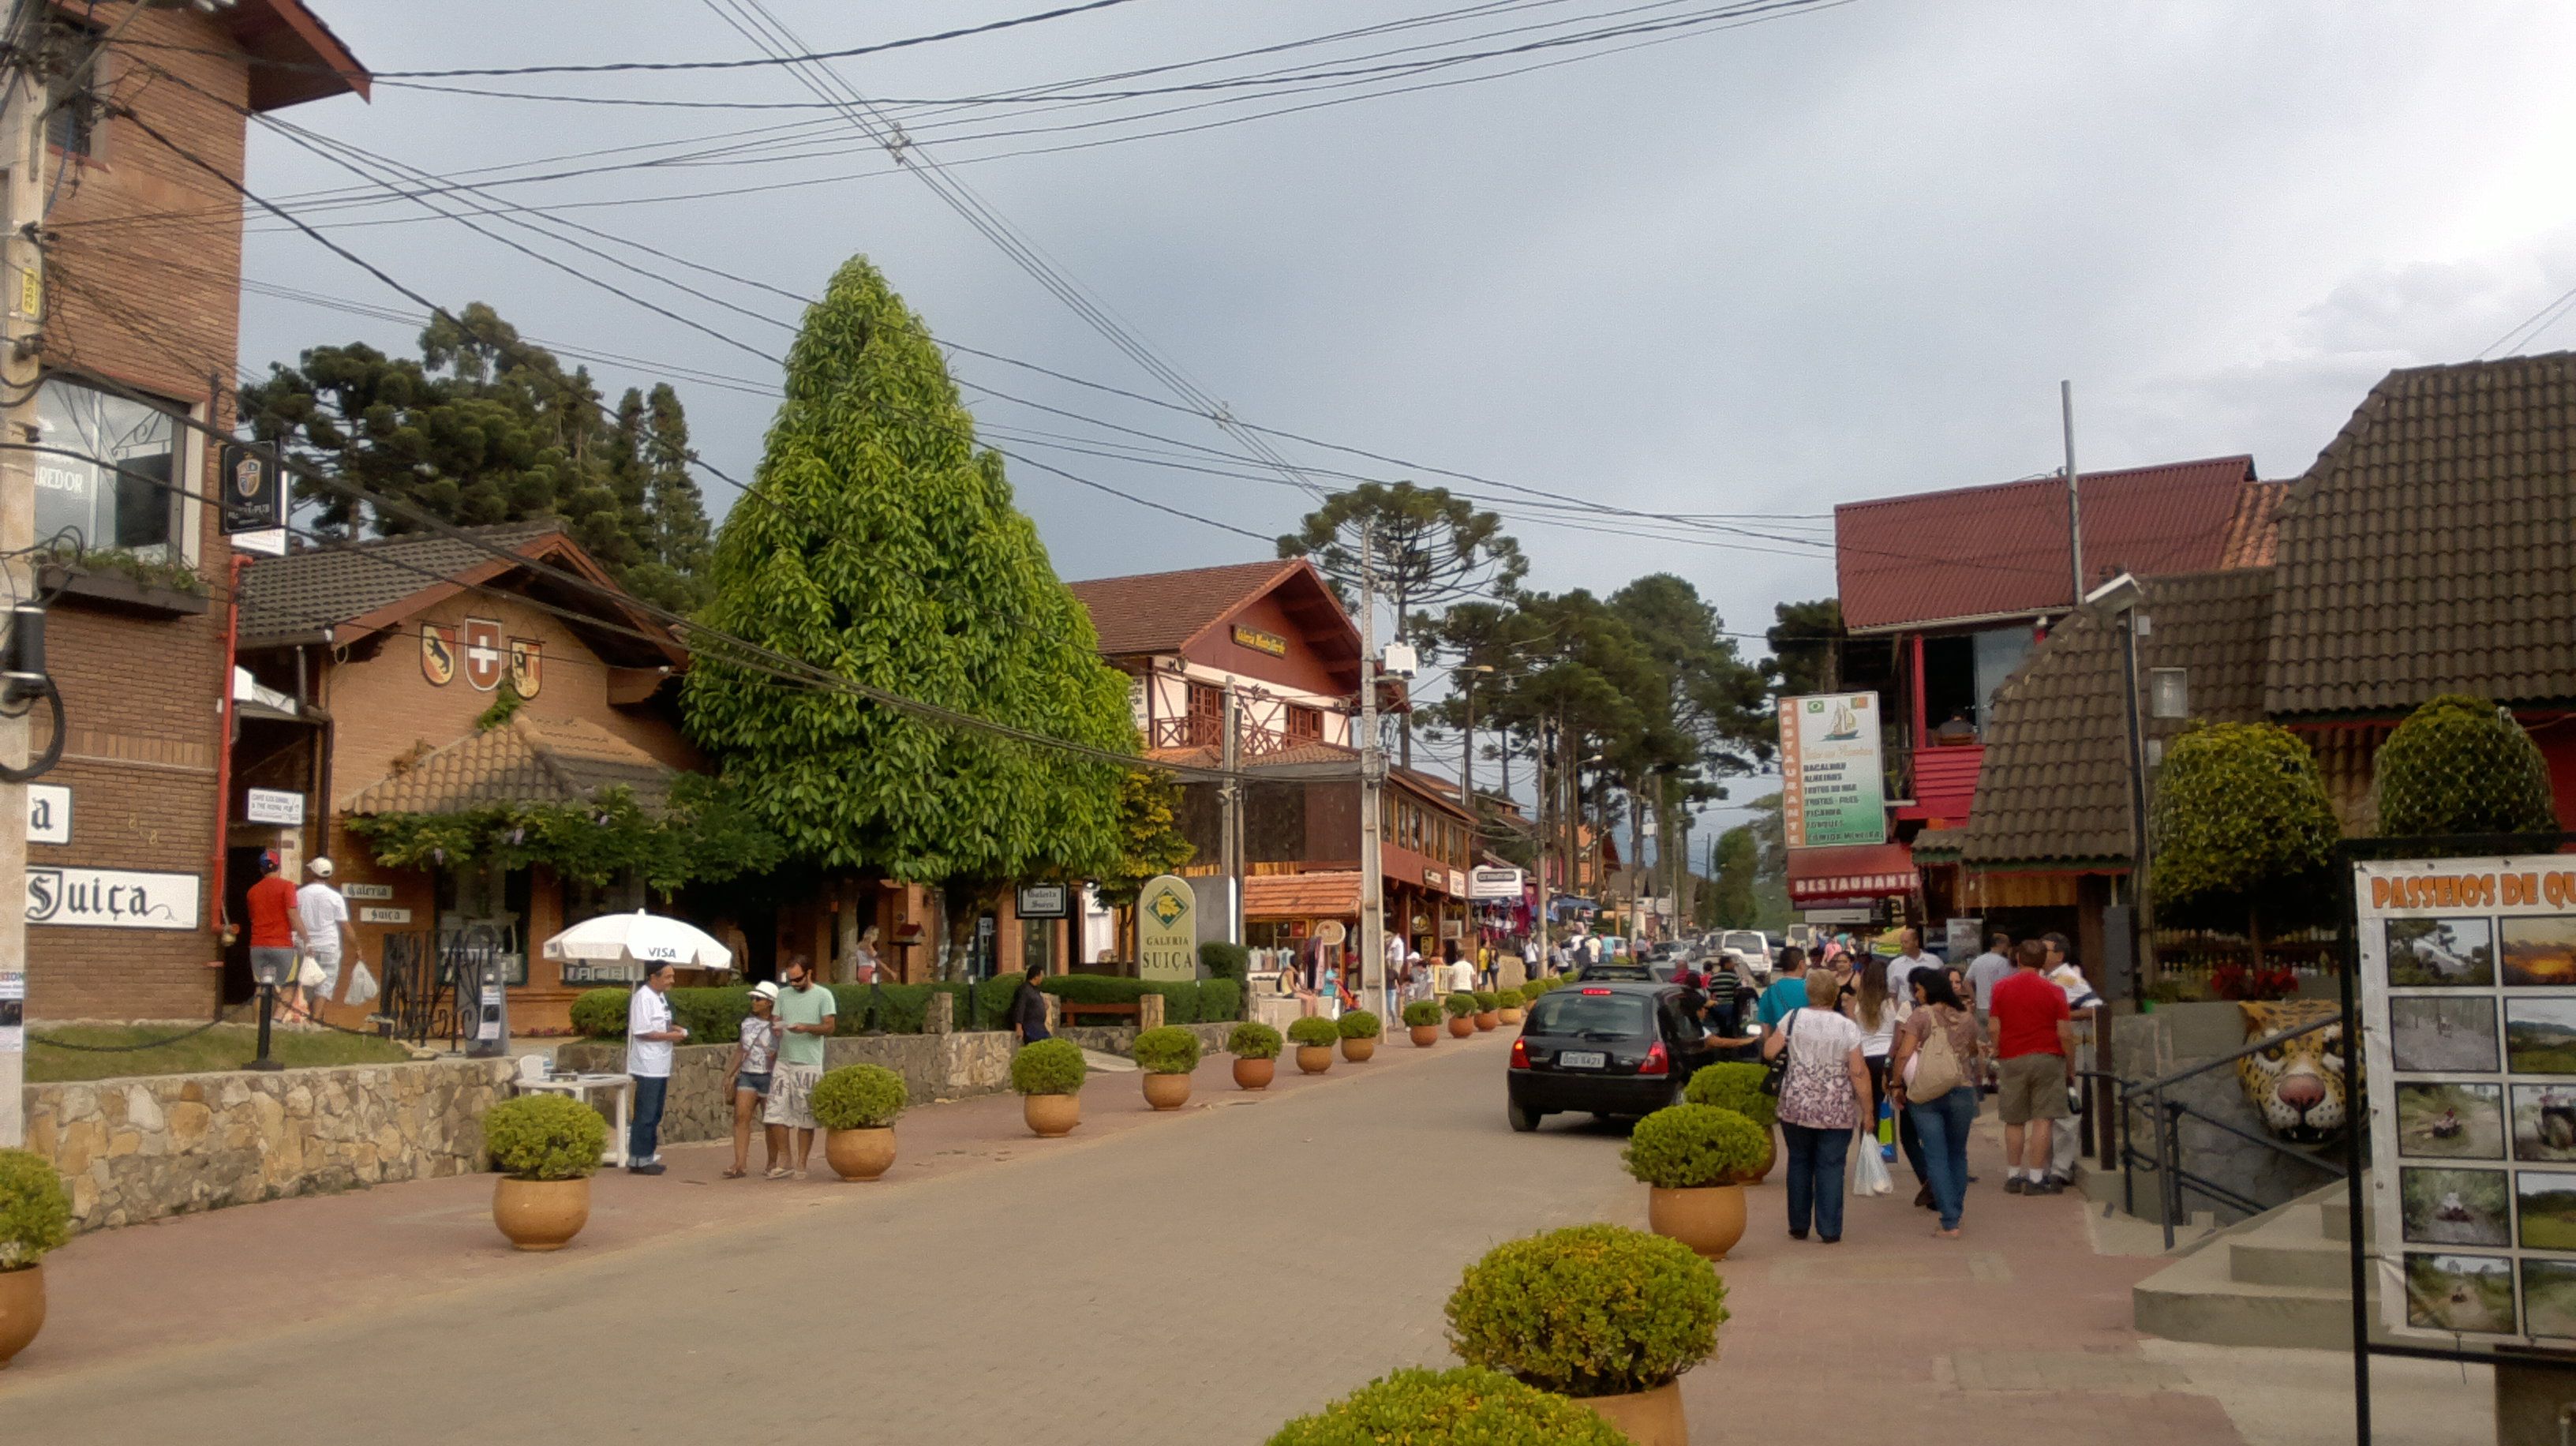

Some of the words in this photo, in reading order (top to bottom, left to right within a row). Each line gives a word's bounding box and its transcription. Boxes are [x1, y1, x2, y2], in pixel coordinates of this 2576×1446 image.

[1781, 702, 1801, 845] RESTAURANTE
[347, 884, 387, 897] Galeria
[1795, 872, 1919, 893] RESTAURANTE
[2370, 873, 2496, 909] PASSEIOS
[2500, 872, 2540, 906] DE
[26, 871, 150, 922] Suiça
[1147, 935, 1189, 946] GALERIA
[648, 947, 676, 959] VISA
[1143, 951, 1193, 972] SUIÇA
